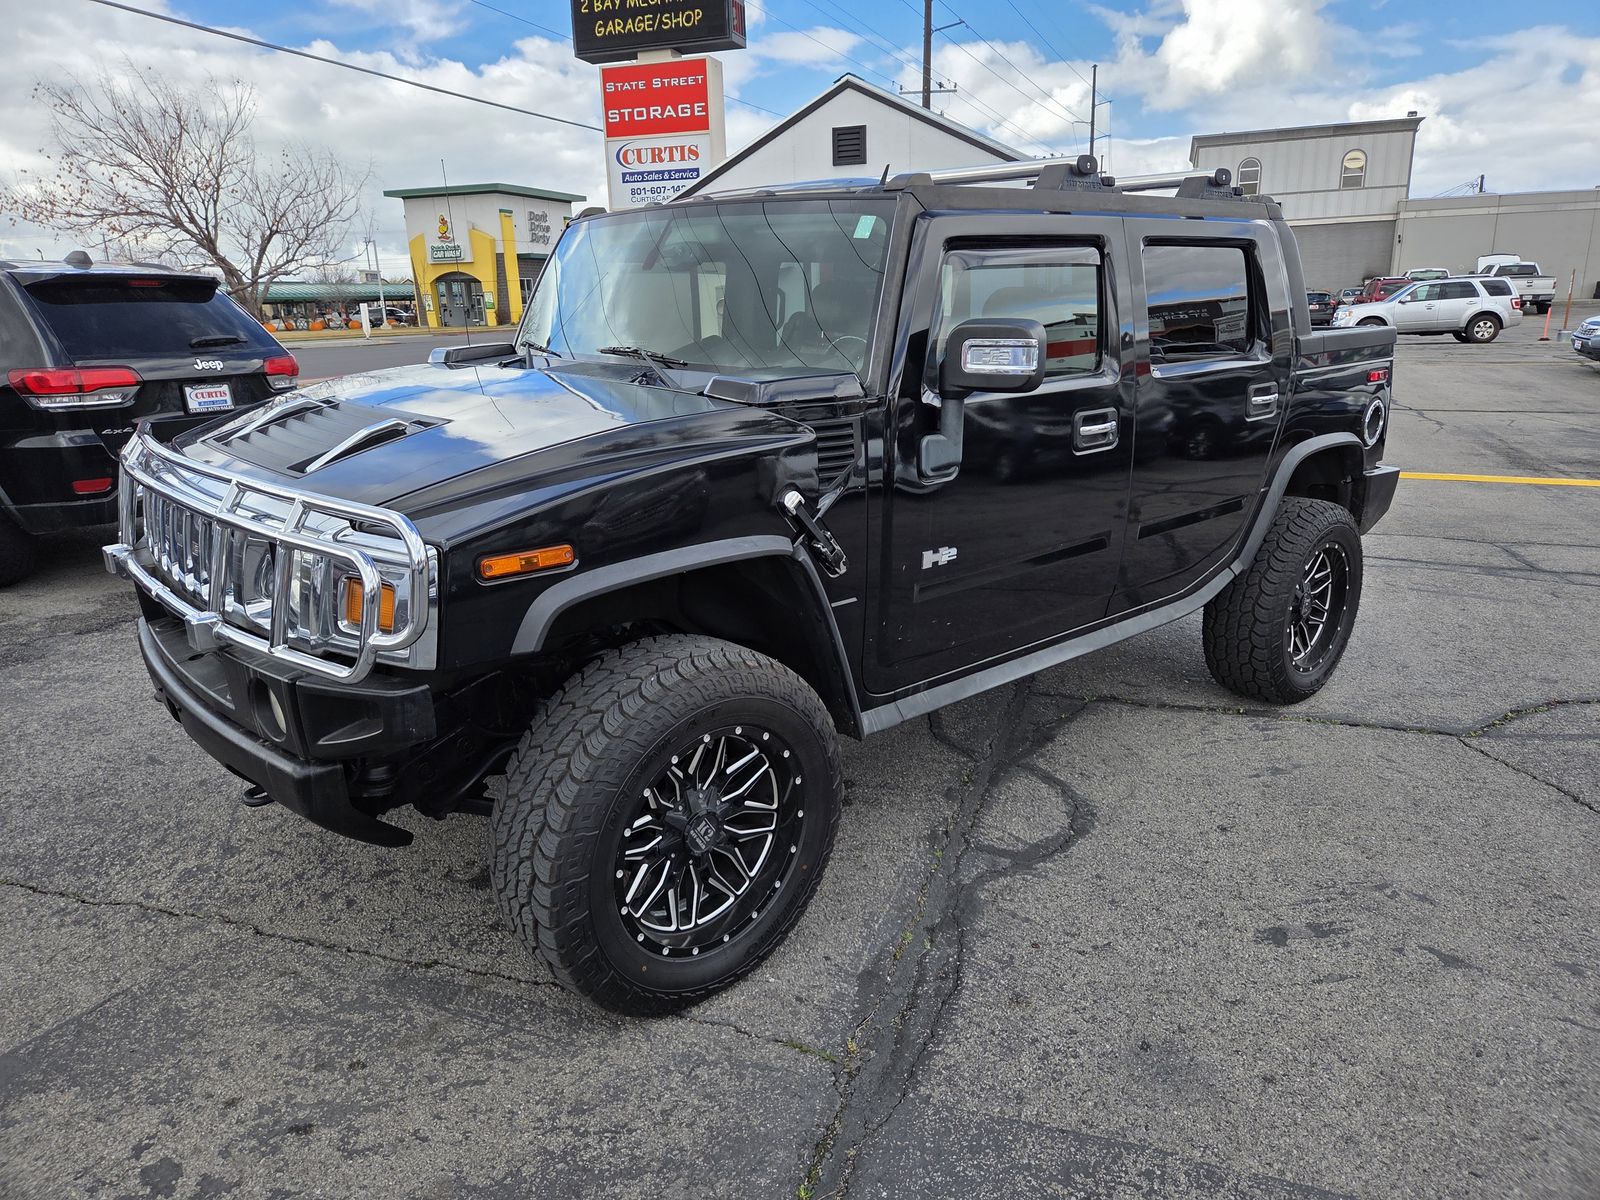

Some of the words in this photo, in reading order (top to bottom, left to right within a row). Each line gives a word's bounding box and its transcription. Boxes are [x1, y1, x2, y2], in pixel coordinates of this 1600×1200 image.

[581, 0, 589, 13] 2
[594, 0, 621, 12] BAY
[595, 9, 703, 37] GARAGE/SHOP
[608, 102, 706, 122] STORAGE
[622, 144, 700, 165] CURTIS
[625, 174, 643, 182] Auto
[643, 172, 663, 181] Sales
[663, 171, 669, 180] &
[670, 170, 698, 179] Service
[630, 184, 687, 196] 801-607-14
[529, 221, 551, 233] Drive
[194, 358, 224, 371] Jeep
[195, 390, 228, 399] CURTIS
[921, 546, 957, 569] H2
